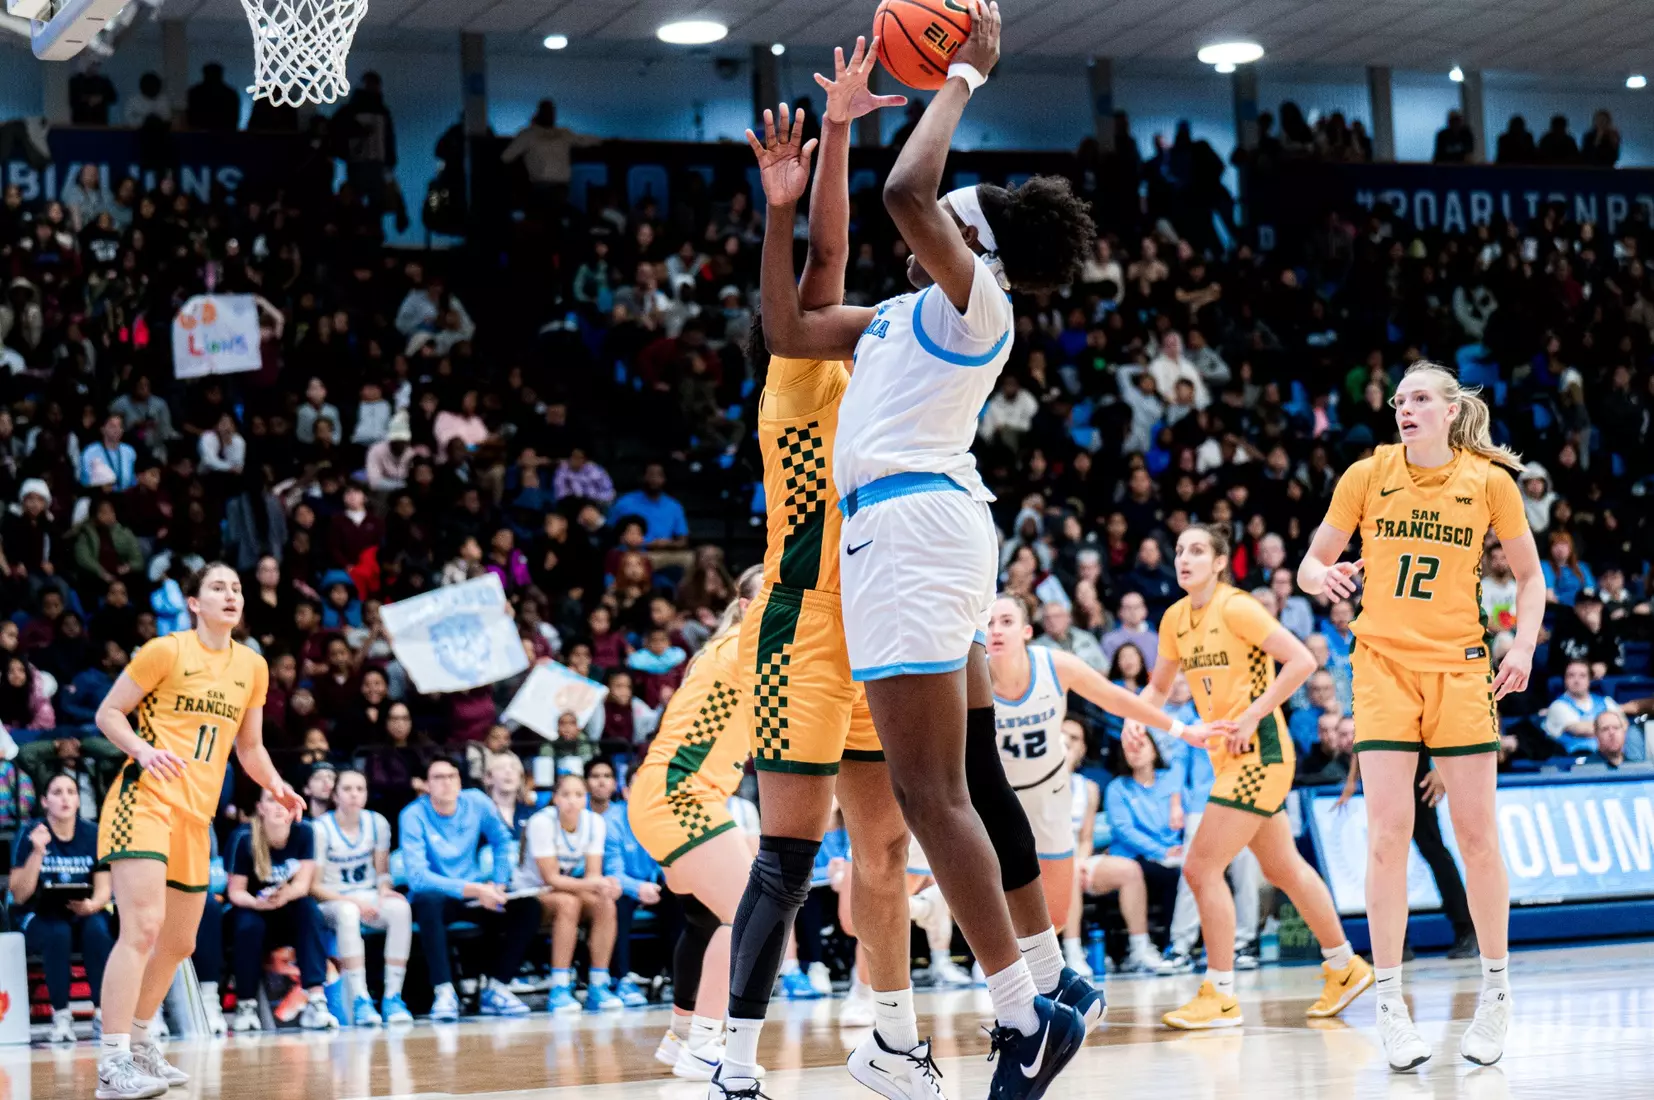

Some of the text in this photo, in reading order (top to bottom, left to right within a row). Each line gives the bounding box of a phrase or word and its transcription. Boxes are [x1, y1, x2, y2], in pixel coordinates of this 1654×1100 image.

[923, 21, 961, 54] ELI
[1411, 509, 1440, 522] SAN
[1374, 518, 1474, 550] FRANCISCO
[1394, 553, 1440, 601] 12
[207, 690, 226, 700] SAN
[194, 723, 218, 763] 11
[1002, 729, 1047, 759] 42
